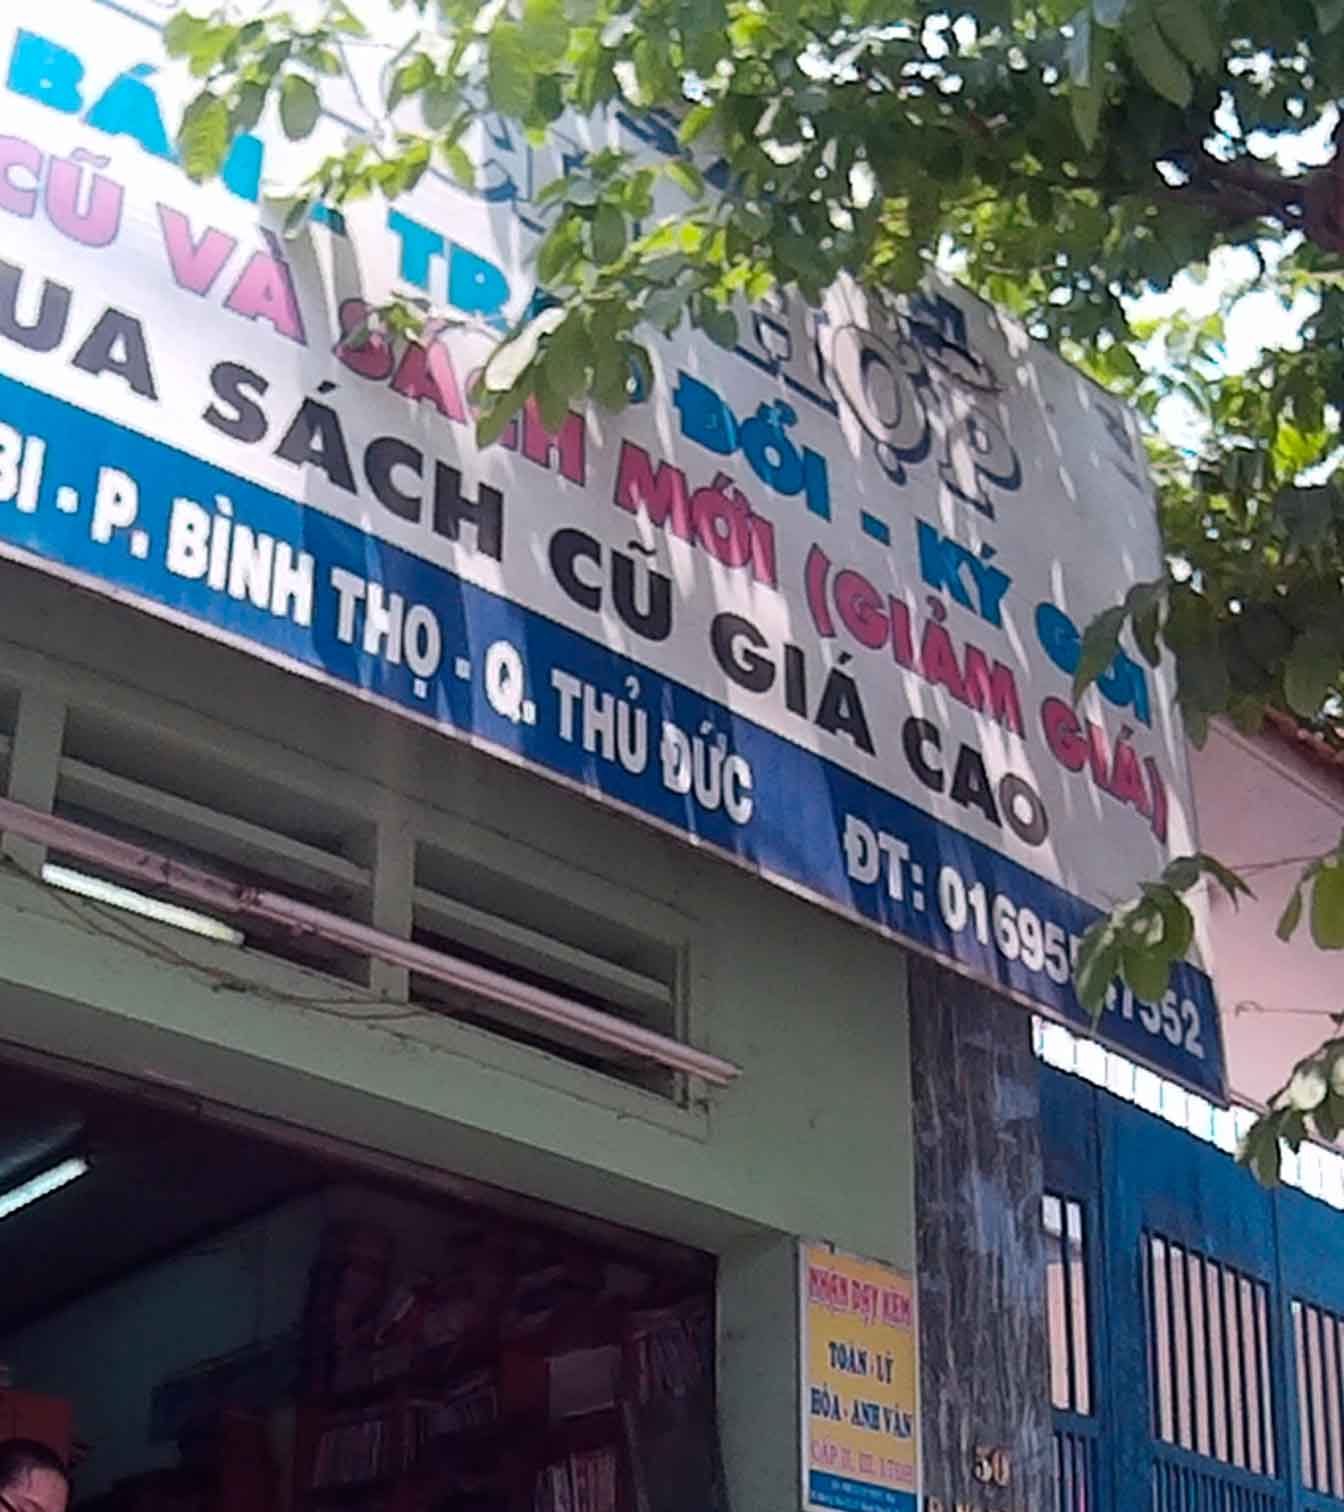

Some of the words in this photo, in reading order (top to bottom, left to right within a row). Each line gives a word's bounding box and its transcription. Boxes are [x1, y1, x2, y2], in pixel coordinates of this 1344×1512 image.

[92, 468, 148, 556] P.
[164, 495, 314, 630] BÌNH
[330, 570, 443, 699] THỌ
[483, 640, 537, 722] Q.
[549, 667, 648, 777] THỦ
[659, 719, 756, 826] ĐỨC
[843, 813, 926, 913] ĐT:
[156, 203, 307, 346] VÀ
[613, 438, 777, 589] MỚI
[805, 543, 1023, 738] (GIẢM
[1041, 696, 1168, 845] GIÁ)
[202, 359, 505, 563] SÁCH
[549, 527, 673, 645] CŨ
[709, 610, 876, 757] GIÁ
[903, 715, 1050, 847] CAO
[918, 517, 1013, 629] KÝ
